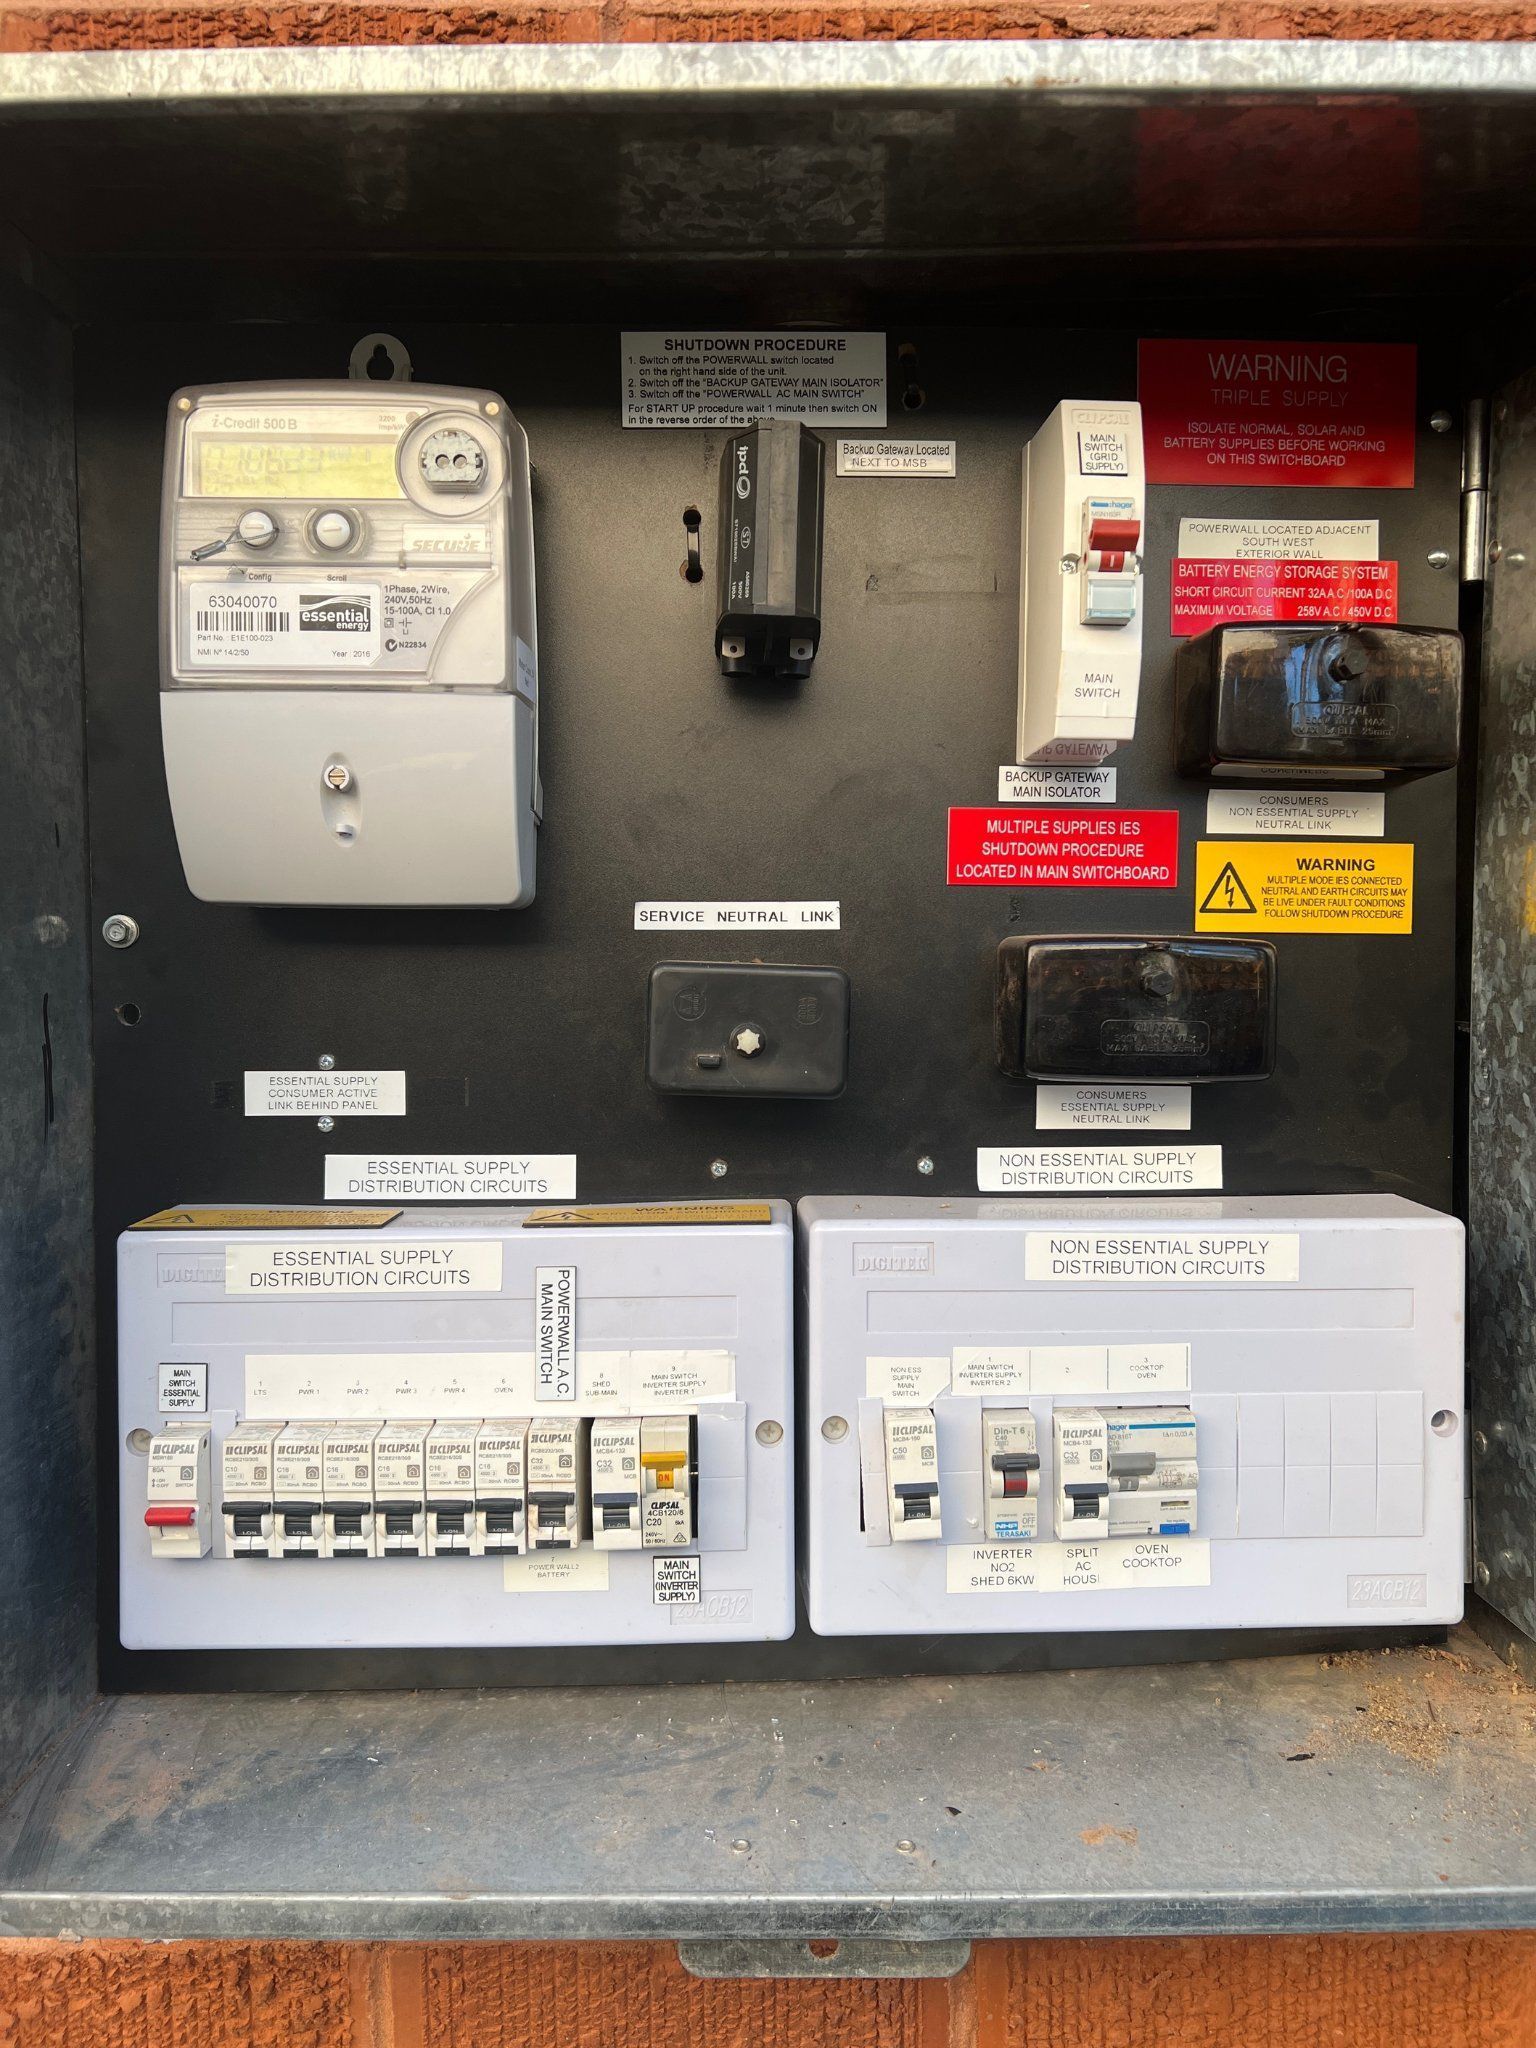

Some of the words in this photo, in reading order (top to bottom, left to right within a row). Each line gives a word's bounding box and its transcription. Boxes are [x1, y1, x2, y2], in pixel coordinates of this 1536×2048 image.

[664, 339, 749, 351] SHUTDOWN
[754, 339, 846, 351] PROCEDURE
[639, 356, 669, 365] Switch
[672, 355, 684, 365] off
[686, 356, 700, 365] the
[703, 356, 768, 365] POWERWALL
[770, 356, 799, 365] switch
[802, 356, 834, 365] located
[1208, 353, 1348, 383] WARNING
[1211, 389, 1271, 406] TRIPLE
[1283, 390, 1348, 408] SUPPLY
[1188, 422, 1236, 433] ISOLATE
[1240, 423, 1293, 436] NORMAL,
[1297, 424, 1337, 435] SOLAR
[1340, 425, 1365, 435] AND
[1090, 434, 1116, 442] MAIN
[916, 443, 949, 456] Located
[1085, 443, 1123, 451] SWITCH
[1164, 437, 1216, 448] BATTERY
[1219, 438, 1275, 449] SUPPLIES
[1279, 439, 1325, 450] BEFORE
[1328, 440, 1385, 452] WORKING
[1090, 453, 1118, 461] (GRID
[1207, 452, 1226, 464] ON
[1229, 453, 1255, 465] THIS
[1259, 453, 1346, 466] SWITCHBOARD
[852, 458, 880, 468] NEXT
[884, 458, 899, 468] TO
[903, 458, 927, 468] MSB
[1086, 463, 1124, 471] SUPPLY)
[1189, 523, 1258, 533] POWERWALL
[1262, 524, 1312, 534] LOCATED
[1315, 525, 1371, 535] ADJACENT
[412, 536, 480, 552] SECURE
[1242, 537, 1279, 547] SOUTH
[1283, 537, 1314, 547] WEST
[1236, 549, 1289, 559] EXTERIOR
[1293, 549, 1323, 559] WALL
[248, 573, 272, 582] Config
[1179, 564, 1229, 577] BATTERY
[1233, 564, 1281, 578] ENERGY
[1284, 565, 1338, 579] STORAGE
[1342, 566, 1388, 580] SYSTEM
[327, 574, 347, 582] Scroll
[384, 585, 419, 595] 1Phase,
[421, 585, 450, 595] 2Wire,
[1175, 586, 1210, 597] SHORT
[1212, 586, 1254, 598] CIRCUIT
[1256, 587, 1305, 598] CURRENT
[209, 595, 277, 609] 63040070
[302, 607, 369, 623] essential
[1175, 604, 1223, 615] MAXIMUM
[1227, 605, 1273, 616] VOLTAGE
[1297, 606, 1321, 617] 258V
[336, 620, 369, 632] energy
[398, 641, 427, 649] N22834
[1085, 673, 1113, 683] MAIN
[1075, 687, 1120, 698] SWITCH
[1006, 771, 1052, 782] BACKUP
[1055, 772, 1110, 782] GATEWAY
[1013, 786, 1041, 797] MAIN
[1045, 787, 1100, 798] ISOLATOR
[1259, 796, 1329, 806] CONSUMERS
[1229, 807, 1252, 816] NON
[1257, 808, 1313, 817] ESSENTIAL
[1317, 809, 1359, 818] SUPPLY
[987, 820, 1049, 834] MULTIPLE
[1053, 821, 1116, 835] SUPPLIES
[1120, 822, 1140, 835] IES
[1256, 820, 1304, 829] NEUTRAL
[1308, 820, 1332, 829] LINK
[982, 842, 1058, 856] SHUTDOWN
[1062, 843, 1144, 857] PROCEDURE
[1296, 858, 1375, 872] WARNING
[956, 864, 1016, 878] LOCATED
[1020, 865, 1033, 879] IN
[1037, 865, 1069, 879] MAIN
[1073, 866, 1169, 880] SWITCHBOARD
[640, 910, 704, 922] SERVICE
[717, 911, 788, 922] NEUTRAL
[801, 911, 834, 922] LINK
[269, 1076, 330, 1087] ESSENTIAL
[333, 1076, 378, 1086] SUPPLY
[268, 1088, 334, 1098] CONSUMER
[337, 1088, 378, 1098] ACTIVE
[1076, 1090, 1147, 1100] CONSUMERS
[268, 1101, 293, 1111] LINK
[296, 1100, 339, 1110] BEHIND
[342, 1100, 378, 1110] PANEL
[1061, 1102, 1120, 1112] ESSENTIAL
[1123, 1103, 1165, 1112] SUPPLY
[1072, 1114, 1123, 1123] NEUTRAL
[1126, 1114, 1150, 1123] LINK
[1000, 1153, 1035, 1167] NON
[1040, 1153, 1128, 1167] ESSENTIAL
[1133, 1152, 1196, 1166] SUPPLY
[368, 1161, 459, 1175] ESSENTIAL
[464, 1161, 530, 1175] SUPPLY
[1002, 1171, 1113, 1185] DISTRIBUTION
[1118, 1170, 1193, 1184] CIRCUITS
[349, 1179, 465, 1193] DISTRIBUTION
[470, 1179, 548, 1193] CIRCUITS
[1050, 1239, 1089, 1254] NON
[1096, 1240, 1193, 1255] ESSENTIAL
[1199, 1240, 1269, 1255] SUPPLY
[273, 1251, 374, 1266] ESSENTIAL
[380, 1249, 453, 1265] SUPPLY
[858, 1256, 929, 1272] DIGITEK
[1053, 1260, 1176, 1275] DISTRIBUTION
[1182, 1260, 1265, 1275] CIRCUITS
[250, 1271, 378, 1287] DISTRIBUTION
[384, 1269, 470, 1286] CIRCUITS
[541, 1283, 553, 1320] MAIN
[557, 1270, 570, 1366] POWERWALL
[540, 1325, 553, 1384] SWITCH
[557, 1368, 570, 1397] A.C.
[163, 1389, 200, 1397] ESSENTIAL
[169, 1399, 195, 1407] SUPPLY
[900, 1425, 933, 1435] CLIPSAL
[1070, 1428, 1102, 1439] CLIPSAL
[539, 1433, 572, 1444] CLIPSAL
[602, 1437, 635, 1447] CLIPSAL
[162, 1444, 195, 1455] CLIPSAL
[234, 1445, 267, 1455] CLIPSAL
[286, 1445, 320, 1455] CLIPSAL
[335, 1444, 369, 1454] CLIPSAL
[387, 1443, 420, 1453] CLIPSAL
[438, 1444, 471, 1454] CLIPSAL
[487, 1440, 521, 1451] CLIPSAL
[651, 1501, 679, 1509] CLIPSAL
[646, 1518, 662, 1526] C20
[973, 1549, 1032, 1560] INVERTER
[1066, 1547, 1099, 1559] SPLIT
[1135, 1544, 1169, 1555] OVEN
[664, 1560, 690, 1570] MAIN
[990, 1563, 1015, 1573] NO2
[1075, 1561, 1091, 1572] AC
[1122, 1557, 1182, 1568] COOKTOP
[657, 1571, 696, 1580] SWITCH
[971, 1576, 1004, 1586] SHED
[1007, 1576, 1035, 1586] 6KW
[655, 1581, 699, 1591] (INVERTER
[1351, 1581, 1420, 1601] 23ACB12
[659, 1592, 696, 1601] SUPPLY)
